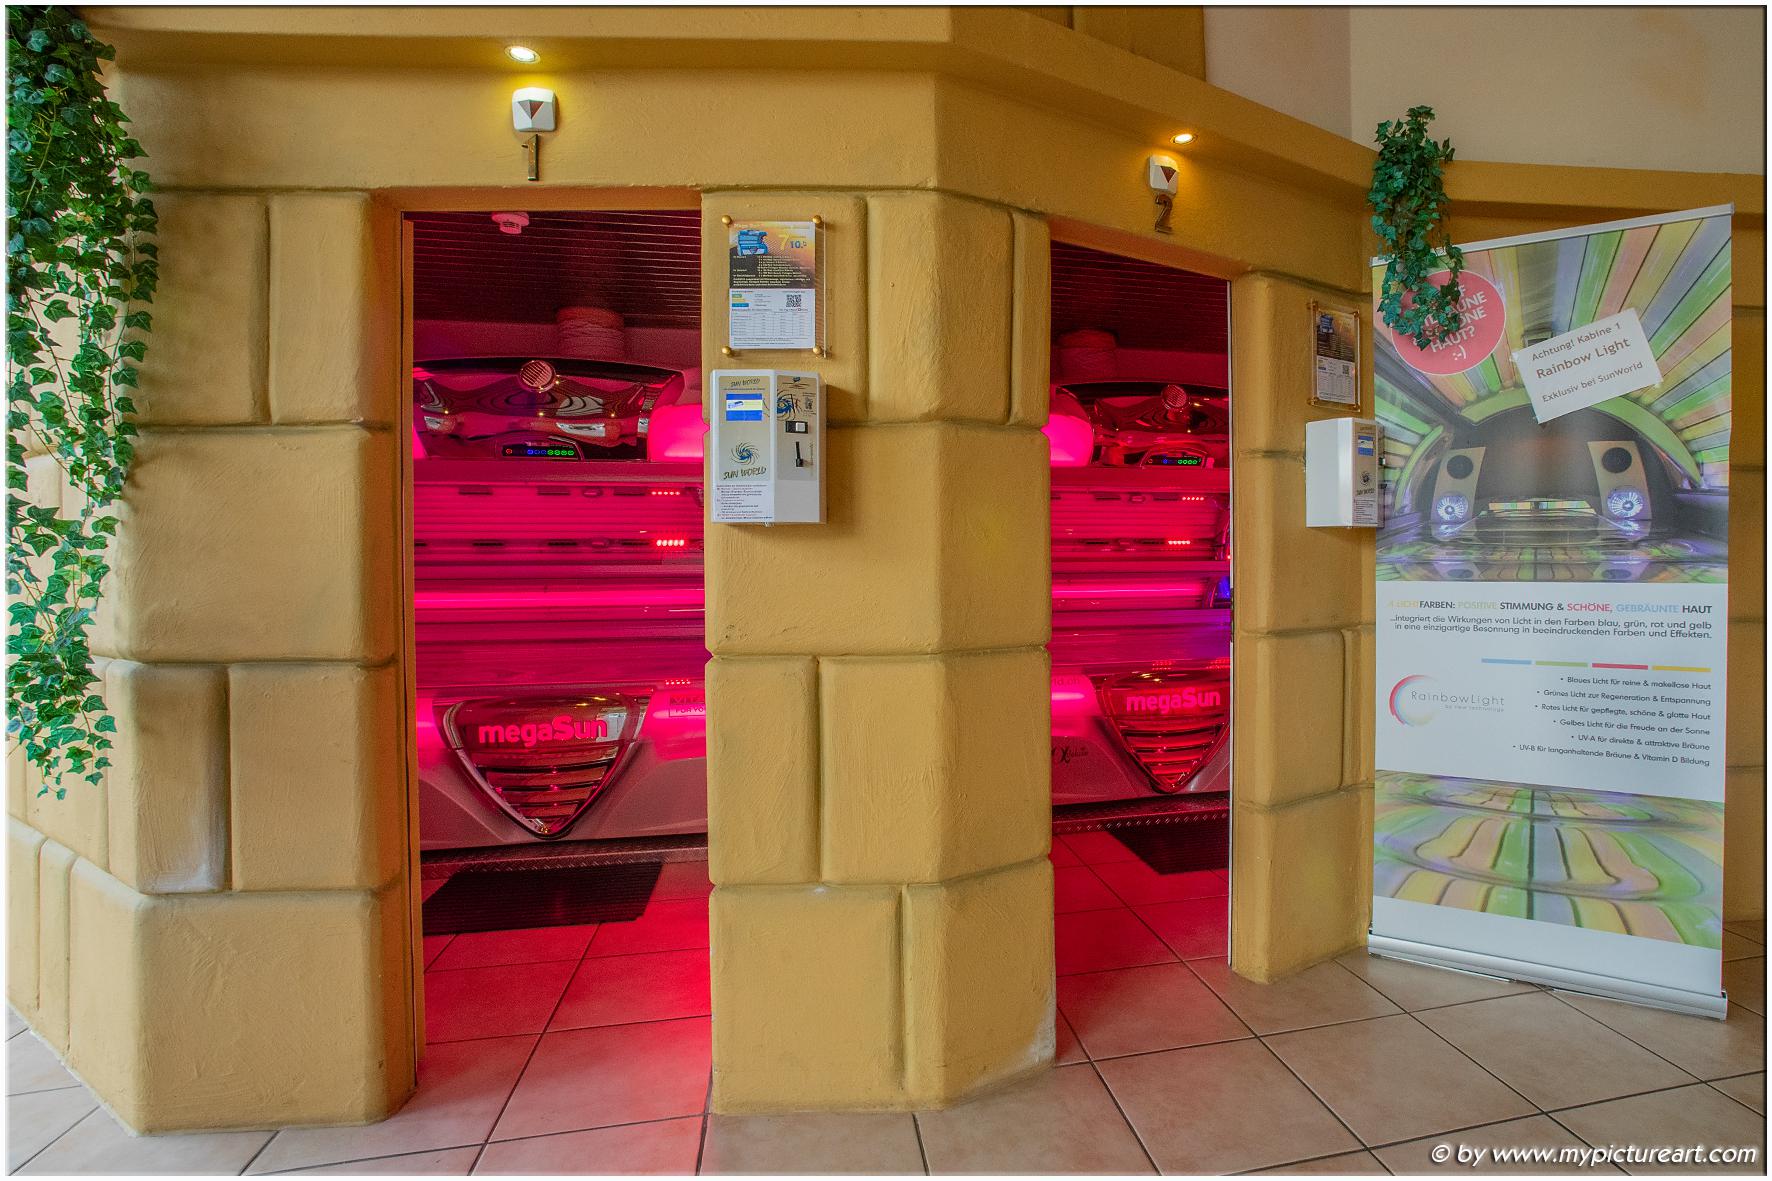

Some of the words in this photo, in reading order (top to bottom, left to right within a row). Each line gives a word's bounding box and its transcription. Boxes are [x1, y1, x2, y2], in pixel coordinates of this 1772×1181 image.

[1155, 193, 1174, 234] 2
[1430, 325, 1476, 352] HAUT?
[1532, 339, 1575, 361] Achtung!
[1577, 326, 1612, 344] Kabine
[1615, 322, 1621, 330] 1
[1536, 352, 1591, 379] Rainbow
[1595, 337, 1631, 358] Light
[1542, 383, 1579, 403] Exklusiv
[1580, 377, 1597, 388] bei
[1597, 361, 1643, 383] SunWorld
[1499, 602, 1554, 611] STIMMUNG
[1556, 603, 1564, 611] &
[1567, 602, 1613, 613] SCHÖNE,
[1616, 603, 1680, 614] GEBRÄUNTE
[1682, 605, 1712, 614] HAUT
[1404, 623, 1421, 631] eine
[1423, 624, 1471, 633] einzigartige
[1473, 625, 1520, 634] Besonnung
[1522, 625, 1530, 634] in
[1532, 626, 1610, 636] beeindruckenden
[1613, 628, 1646, 637] Farben
[1648, 629, 1667, 638] und
[1670, 629, 1712, 639] Effekten.
[1432, 615, 1446, 623] die
[1447, 615, 1493, 625] Wirkungen
[1512, 616, 1531, 625] Licht
[1534, 617, 1542, 625] in
[1544, 617, 1562, 626] den
[1564, 618, 1595, 626] Farben
[1597, 618, 1621, 628] blau,
[1623, 619, 1648, 629] grün,
[1667, 620, 1687, 629] und
[1689, 620, 1712, 631] gelb
[1567, 676, 1591, 684] Blaues
[1592, 677, 1608, 685] Licht
[1610, 678, 1621, 686] für
[1622, 679, 1641, 687] reine
[1651, 680, 1690, 689] makellose
[1692, 682, 1711, 690] Haut
[1126, 687, 1221, 714] megaSun
[1411, 691, 1505, 707] RainbowLight
[1543, 689, 1569, 697] Grünes
[1570, 690, 1586, 698] Licht
[1601, 692, 1650, 702] Regeneration
[1660, 696, 1711, 707] Entspannung
[1541, 703, 1560, 712] Rotes
[1562, 704, 1578, 712] Licht
[1579, 705, 1589, 713] für
[1591, 706, 1628, 716] gepflegte,
[1629, 708, 1656, 717] schöne
[1658, 710, 1665, 718] &
[1666, 711, 1689, 720] glatte
[1691, 712, 1711, 721] Haut
[478, 715, 607, 747] megaSun
[1559, 719, 1585, 727] Gelbes
[1587, 720, 1603, 728] Licht
[1604, 721, 1615, 729] für
[1616, 722, 1628, 730] die
[1630, 723, 1656, 732] Freude
[1670, 725, 1684, 734] der
[1685, 727, 1711, 735] Sonne
[1578, 734, 1596, 742] UV-A
[1597, 735, 1607, 743] für
[1609, 736, 1634, 745] direkte
[1644, 739, 1680, 748] attraktive
[1681, 742, 1710, 750] Bräune
[1548, 746, 1604, 757] langanhaltende
[1605, 751, 1632, 759] Bräune
[1641, 753, 1670, 763] Vitamin
[1680, 756, 1710, 767] Bildung
